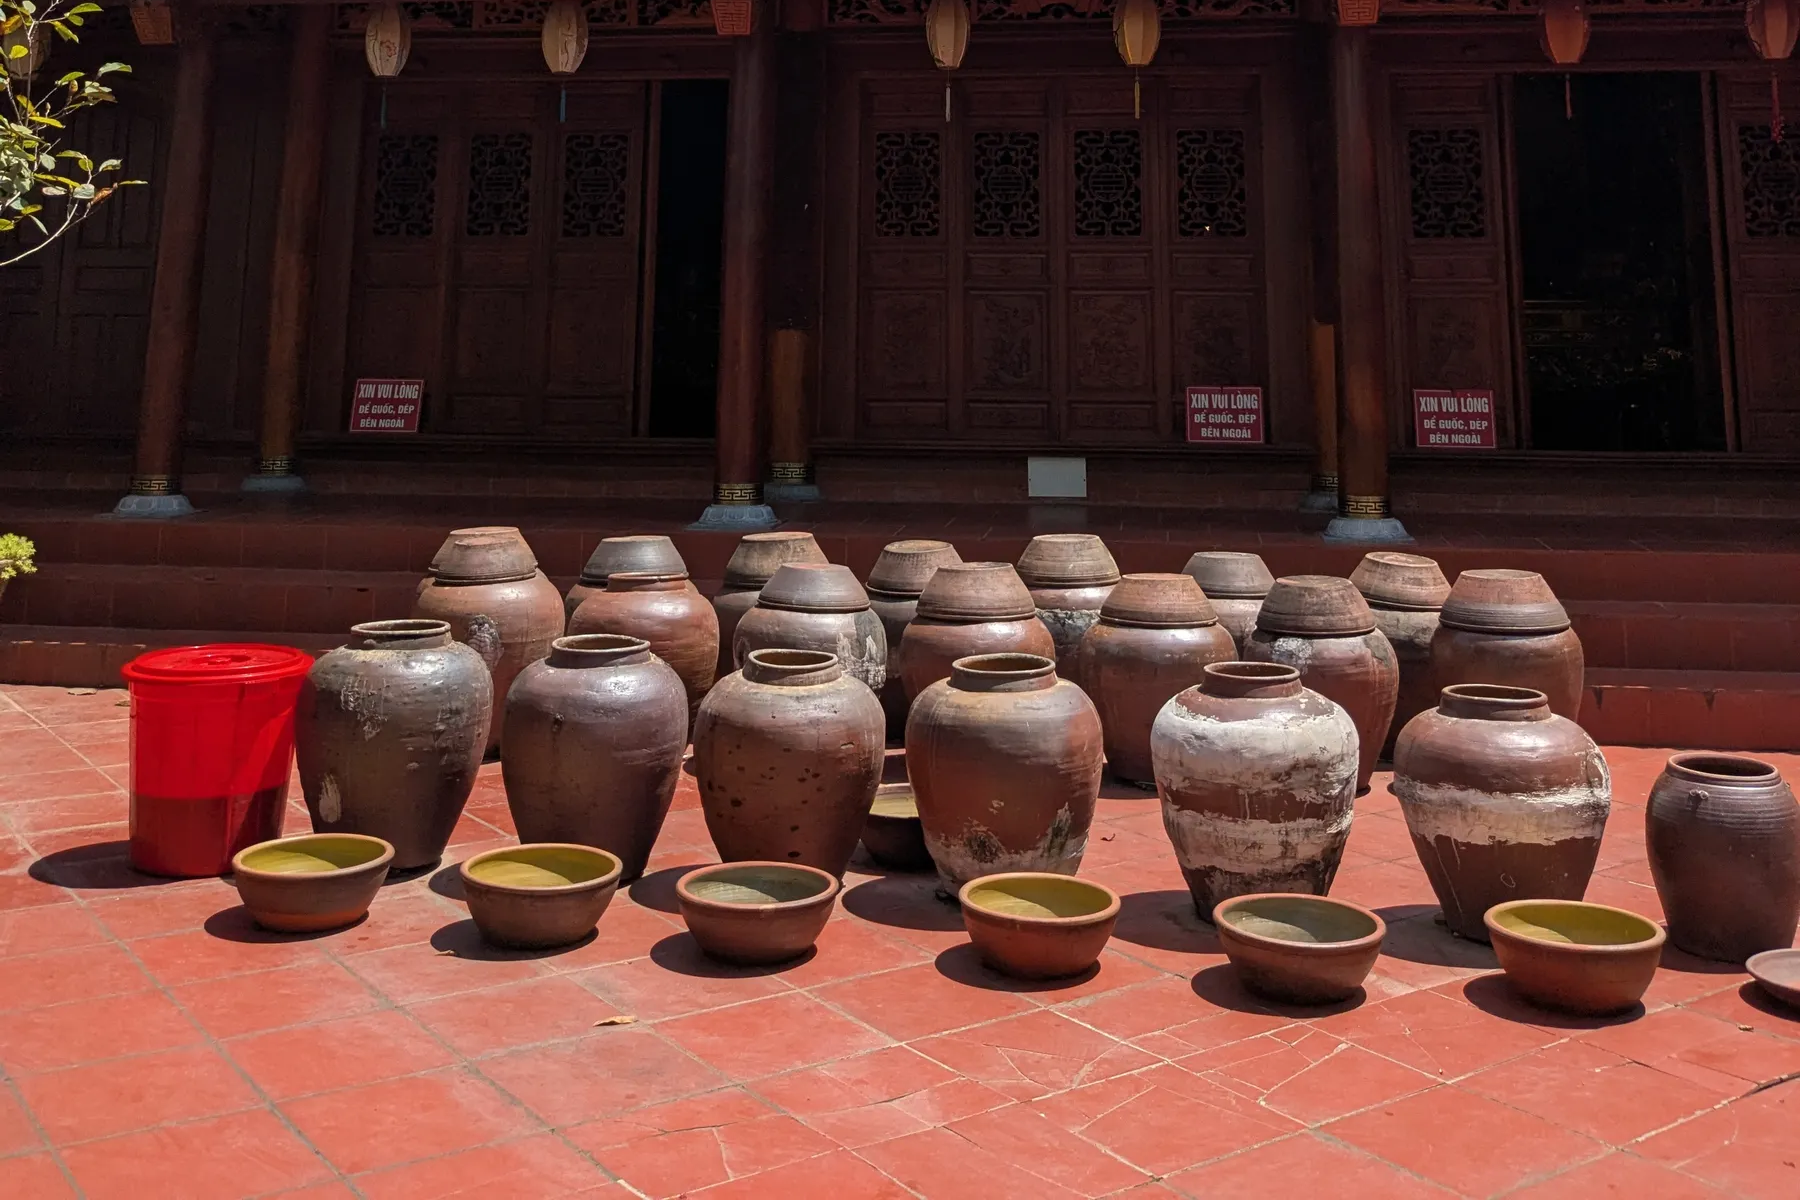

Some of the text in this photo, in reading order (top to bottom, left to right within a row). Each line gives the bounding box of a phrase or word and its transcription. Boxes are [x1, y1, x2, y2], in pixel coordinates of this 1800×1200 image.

[359, 381, 419, 399] XIN VUI LÒNG
[1191, 390, 1258, 409] XIN VUI LÒNG
[1419, 393, 1489, 413] XIN VUI LÒNG
[398, 403, 415, 414] DÉP
[360, 417, 405, 428] BÊN NGOÀI
[1238, 412, 1257, 423] DÉP
[1469, 418, 1488, 430] DÉP
[1201, 425, 1251, 438] BÊN NGOÀI
[1429, 432, 1481, 444] BÊN NGOÀI
